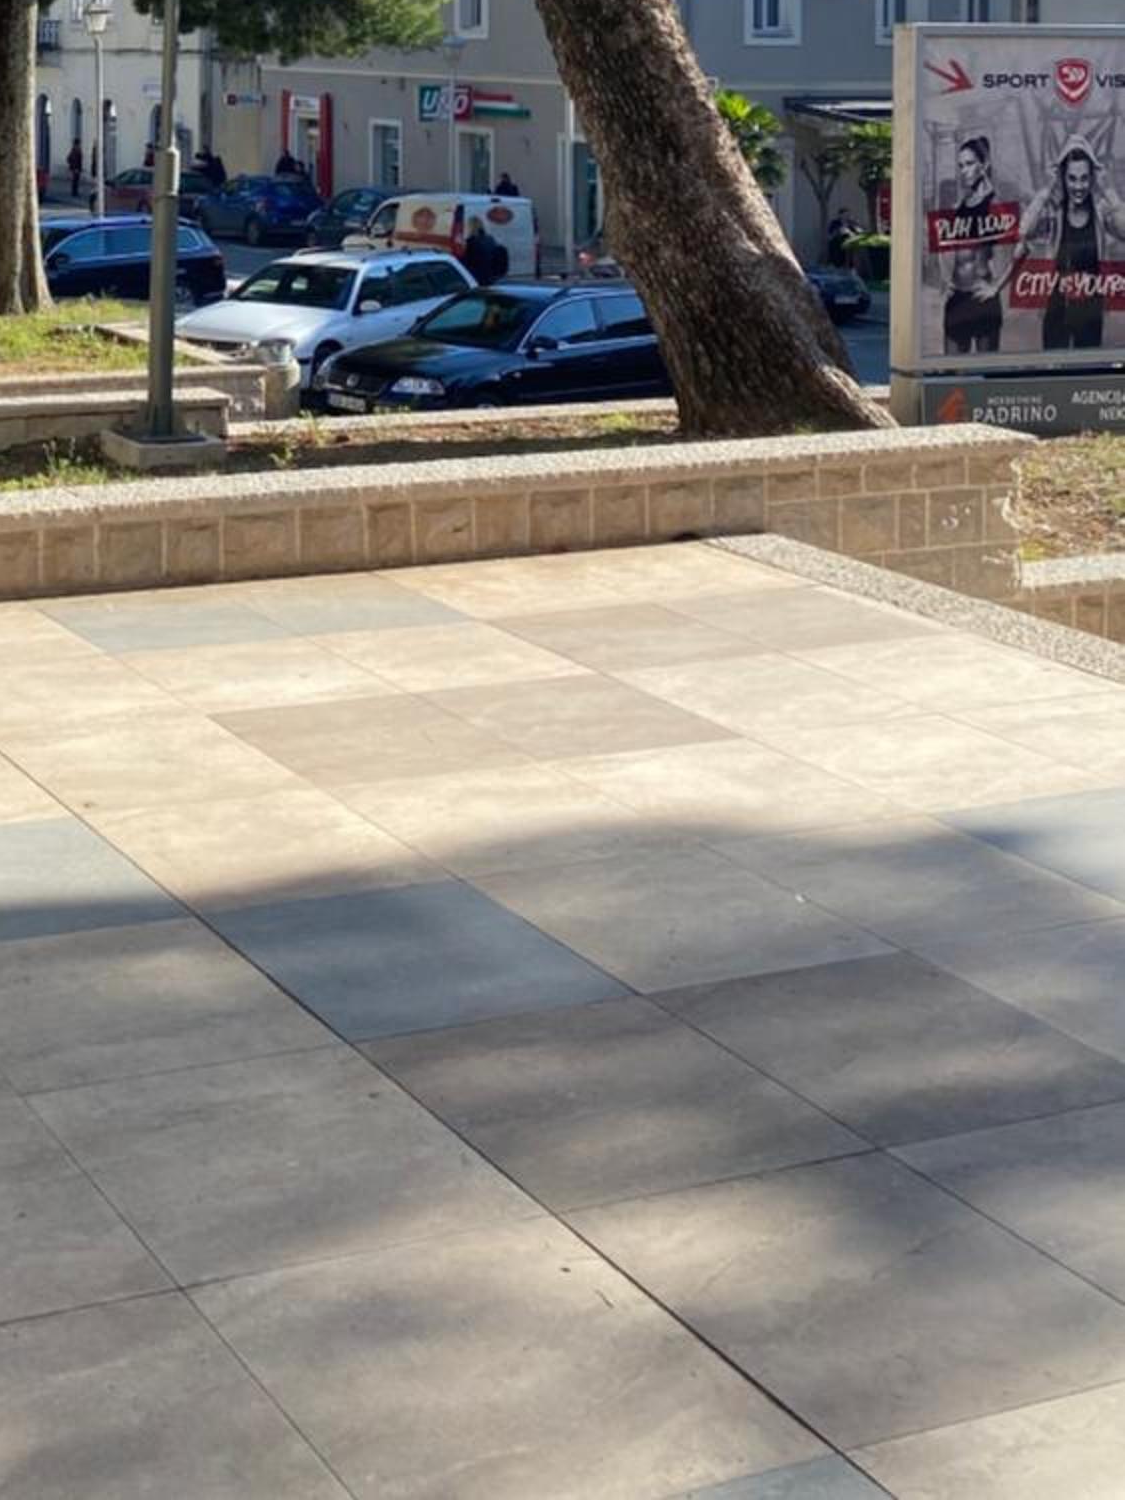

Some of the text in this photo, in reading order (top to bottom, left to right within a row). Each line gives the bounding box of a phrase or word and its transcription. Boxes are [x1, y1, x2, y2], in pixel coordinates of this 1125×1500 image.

[983, 73, 1050, 88] SPORT
[1016, 271, 1059, 296] CITY
[1071, 390, 1125, 404] AGENCIJ
[973, 404, 1058, 423] PADRINO
